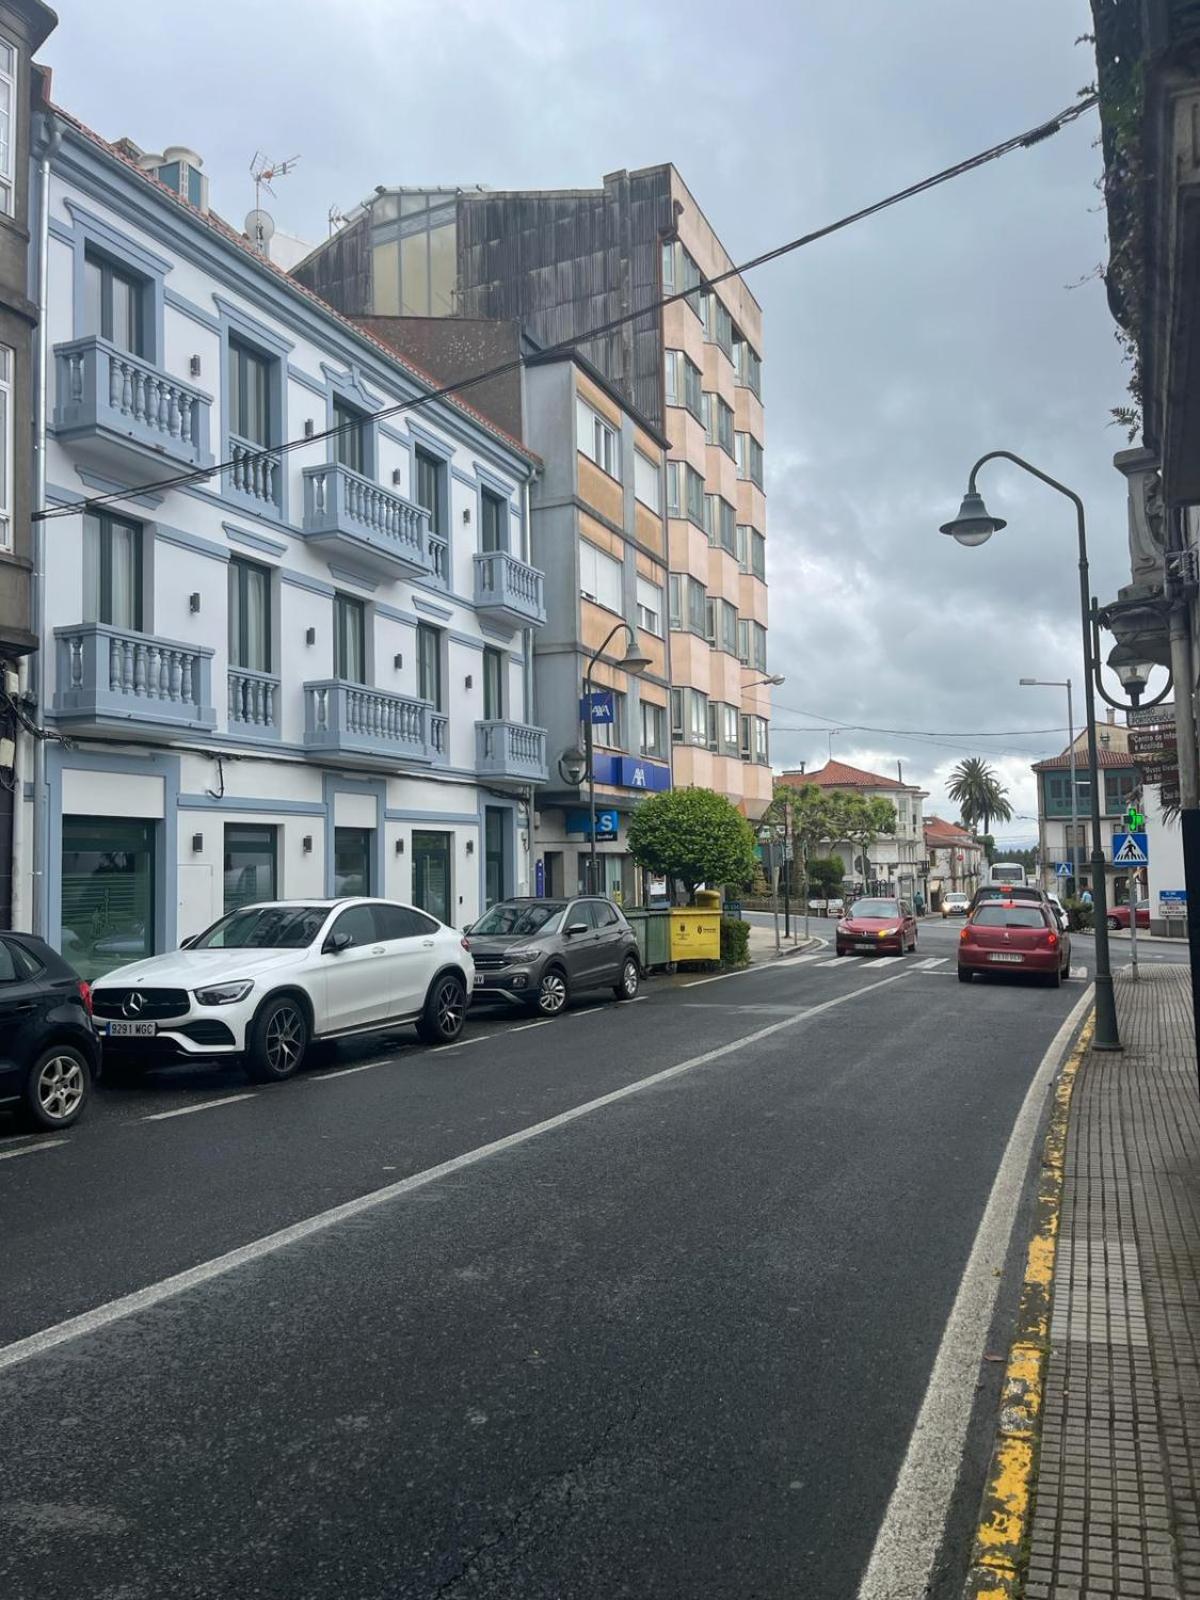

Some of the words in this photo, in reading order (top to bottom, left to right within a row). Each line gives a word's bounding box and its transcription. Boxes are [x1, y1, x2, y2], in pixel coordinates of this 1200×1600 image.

[592, 704, 610, 716] AXA
[632, 768, 646, 786] AXA
[111, 1023, 132, 1035] 9291
